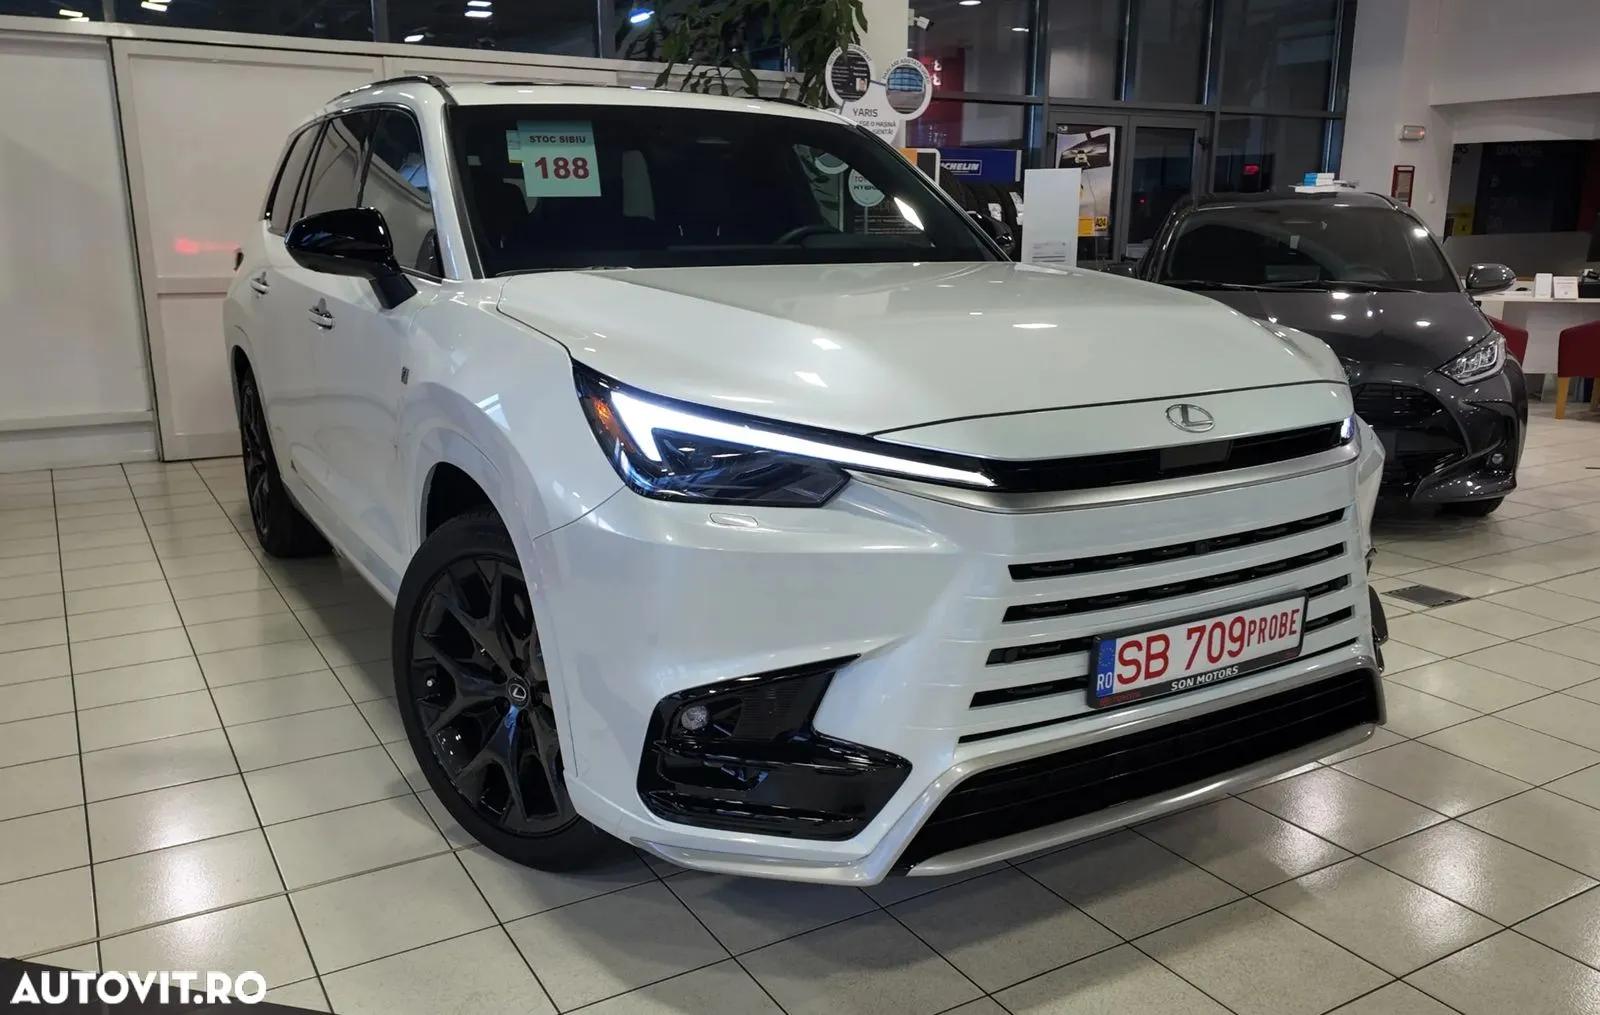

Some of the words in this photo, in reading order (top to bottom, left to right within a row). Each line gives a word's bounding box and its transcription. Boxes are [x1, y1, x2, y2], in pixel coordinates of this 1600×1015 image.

[853, 107, 878, 118] YARIS
[529, 135, 556, 143] STOC
[559, 135, 586, 143] SIBIU
[535, 157, 589, 180] 188
[1117, 634, 1170, 685] SB
[1096, 672, 1112, 691] RO
[1170, 677, 1194, 692] SON
[1197, 665, 1239, 685] MOTORS
